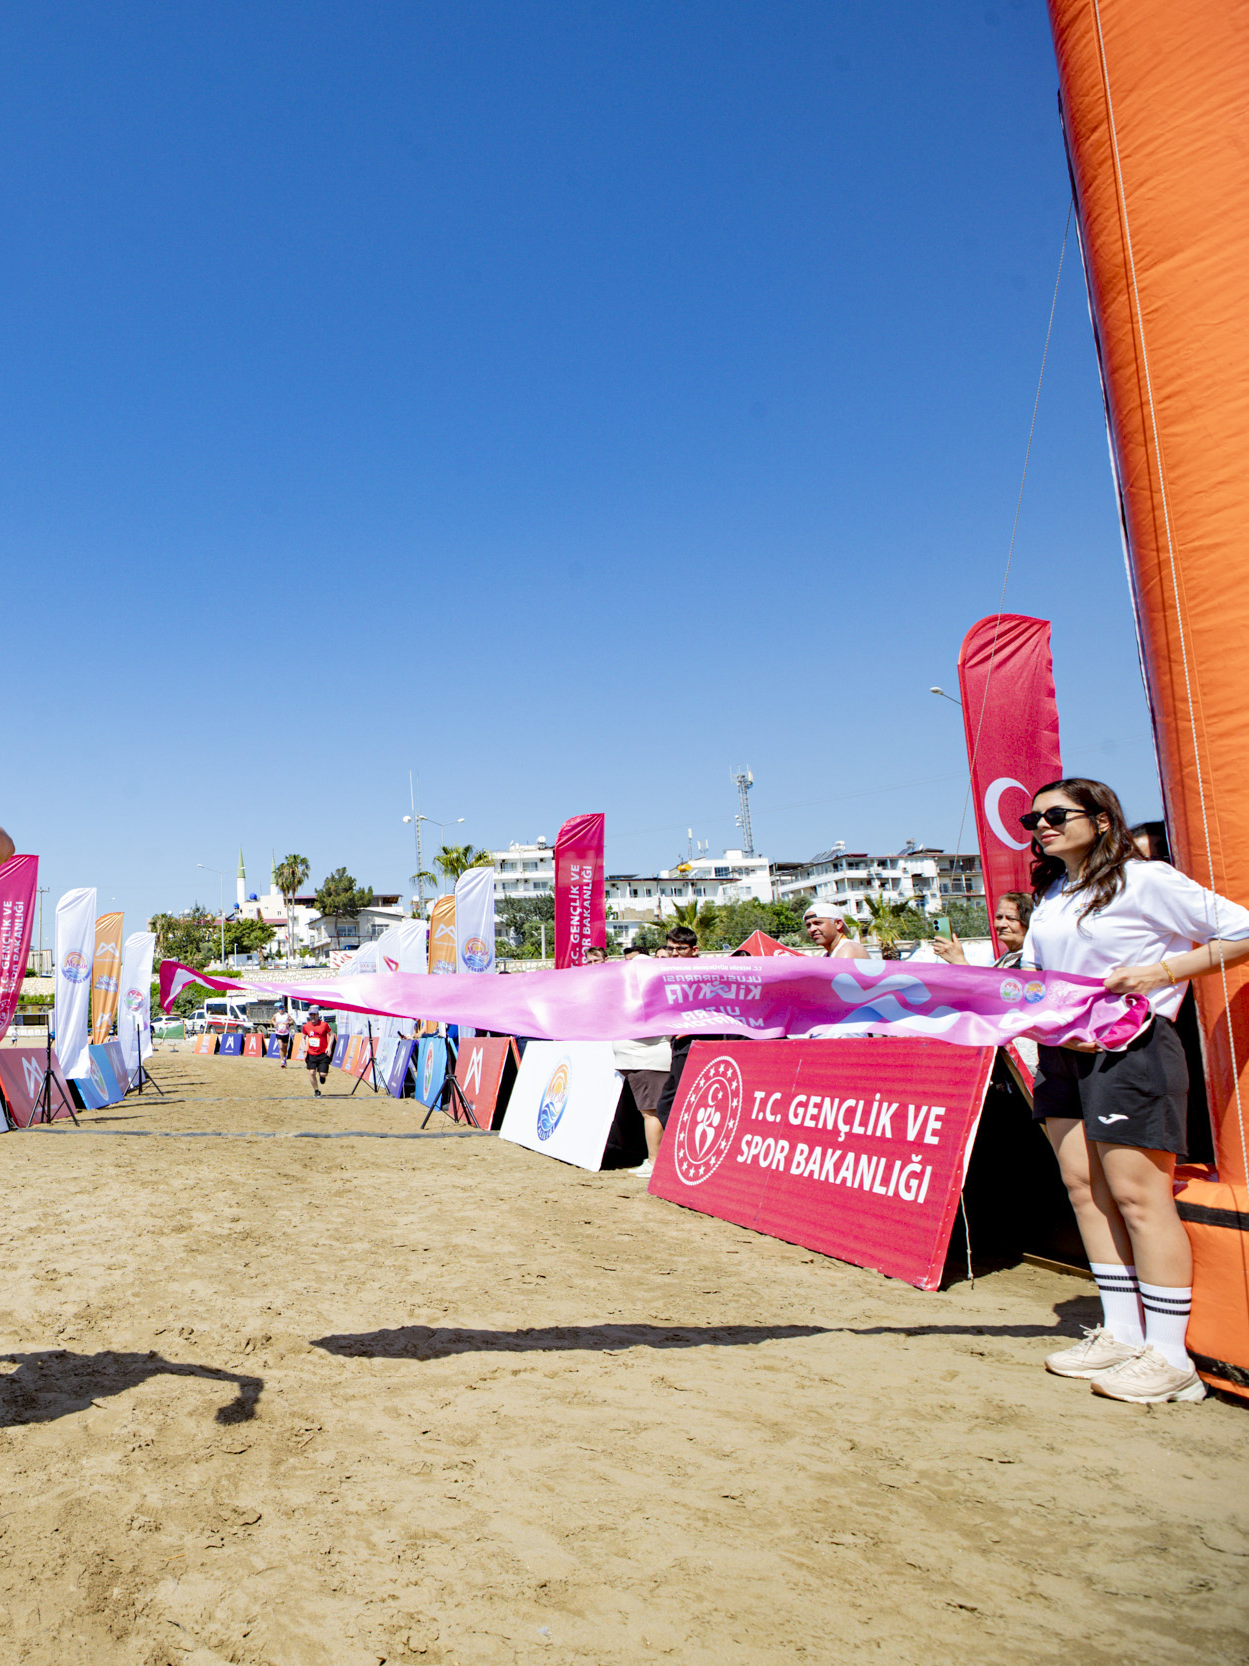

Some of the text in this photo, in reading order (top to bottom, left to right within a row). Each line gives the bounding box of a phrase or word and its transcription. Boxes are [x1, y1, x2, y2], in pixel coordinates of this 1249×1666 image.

[571, 865, 580, 881] VE
[581, 866, 592, 935] BAKANLIĞI
[569, 886, 582, 943] GENÇLİK
[0, 900, 13, 994] T.C. GENÇLİK VE
[751, 1091, 946, 1145] T.C. GENÇLİK VE
[736, 1133, 932, 1204] SPOR BAKANLIĞI
